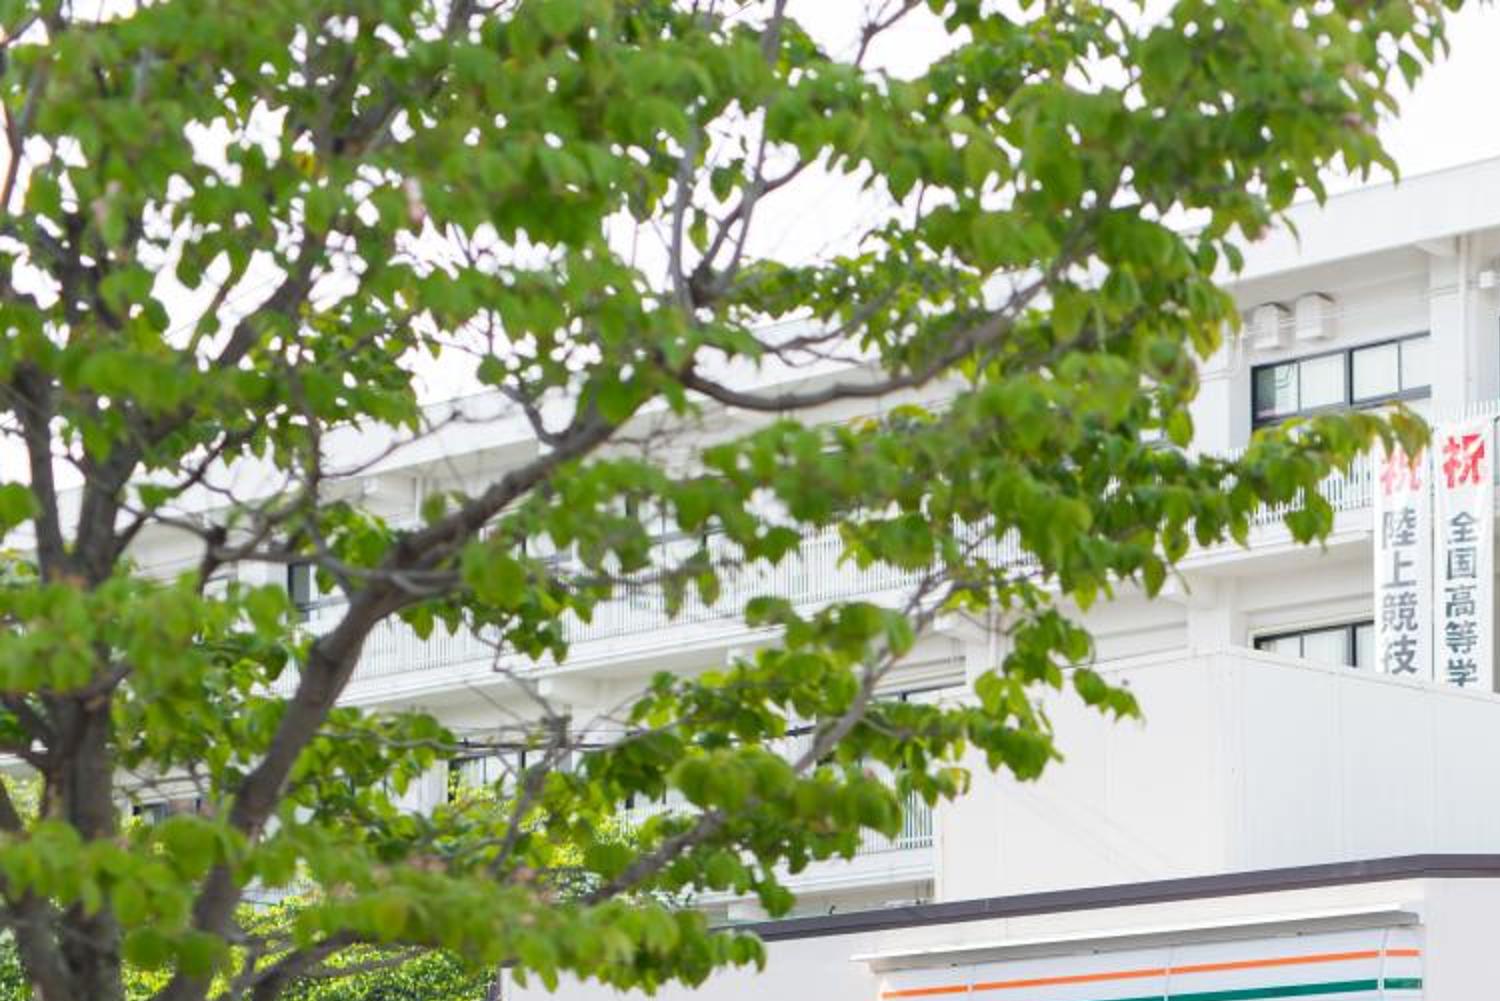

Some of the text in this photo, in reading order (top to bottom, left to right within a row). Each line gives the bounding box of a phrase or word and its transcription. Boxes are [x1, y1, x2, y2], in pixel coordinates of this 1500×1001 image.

[1443, 433, 1486, 489] 祝
[1381, 507, 1419, 676] 陸上競技
